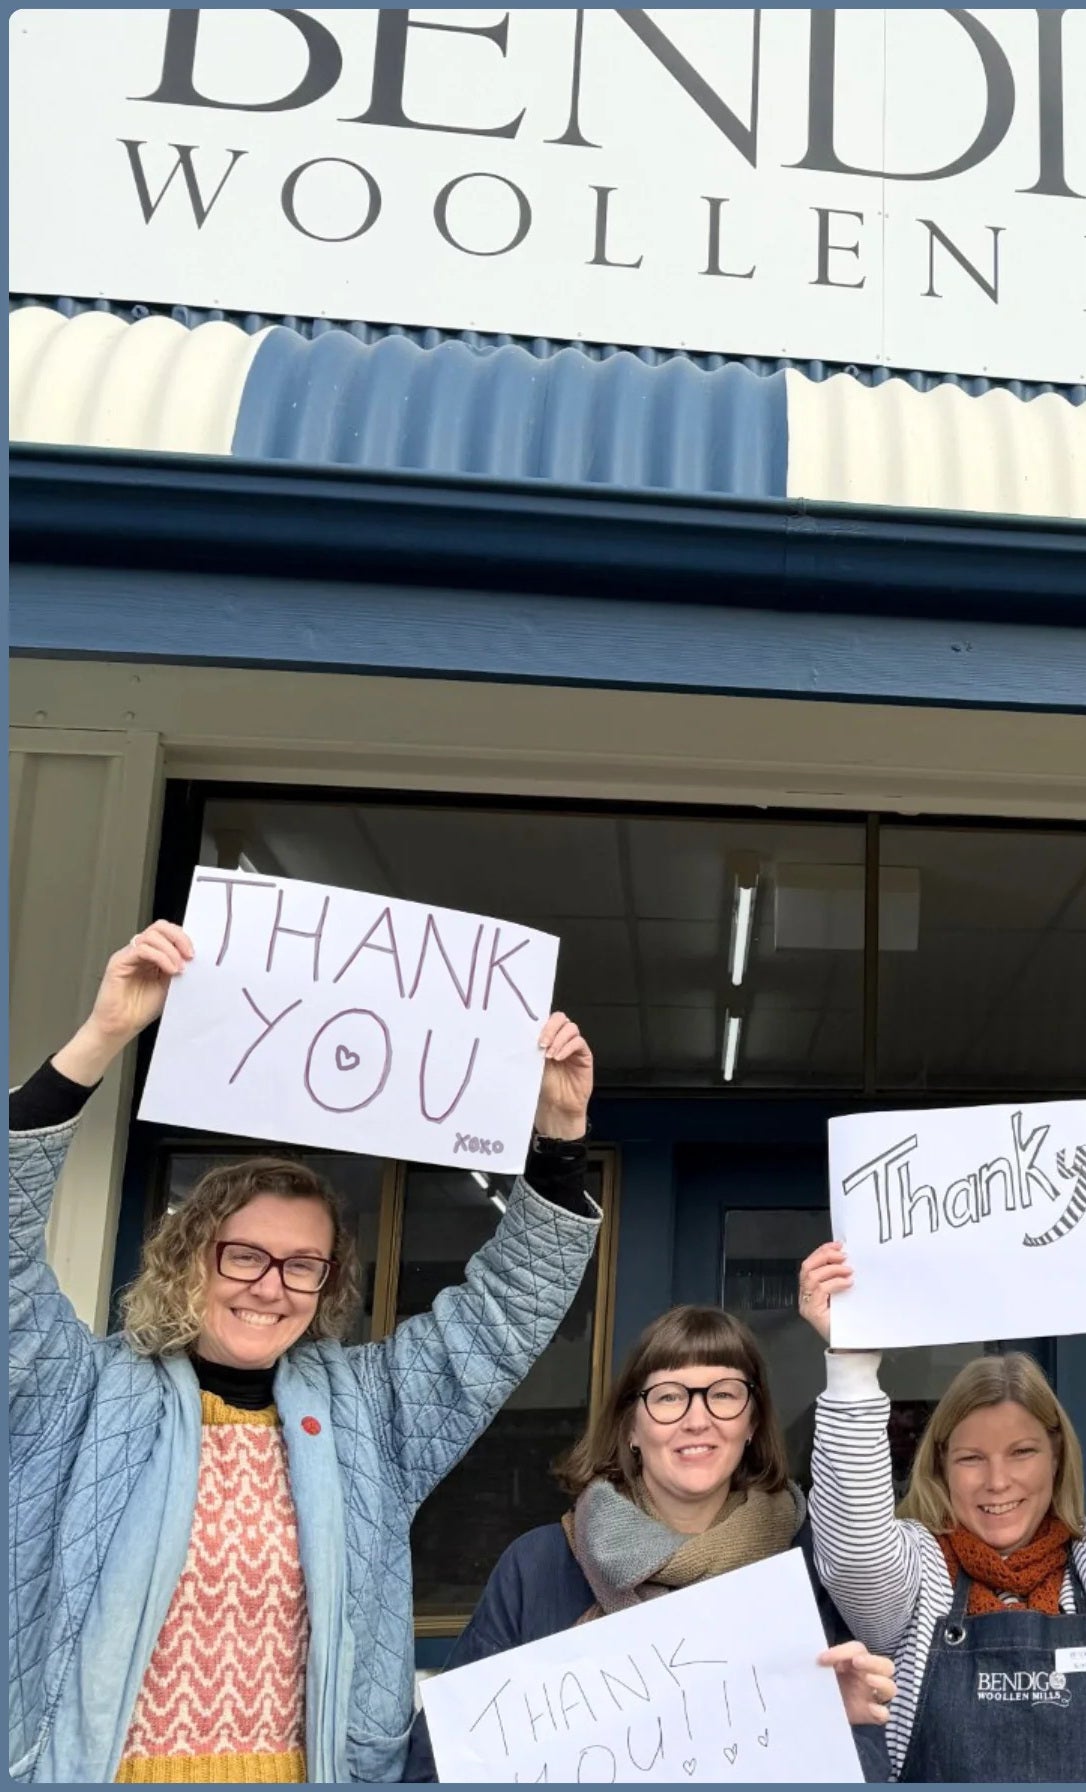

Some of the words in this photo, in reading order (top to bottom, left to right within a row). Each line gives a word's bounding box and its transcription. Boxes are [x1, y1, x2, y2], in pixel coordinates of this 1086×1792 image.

[116, 137, 1007, 306] WOOLLEN
[196, 875, 540, 1022] THANK
[228, 986, 481, 1124] YOU
[842, 1110, 1061, 1245] Thank
[469, 1638, 728, 1756] THANK
[977, 1671, 1066, 1692] BENDIGO
[977, 1691, 1029, 1701] WOOLLEN
[1032, 1690, 1061, 1700] MILLS
